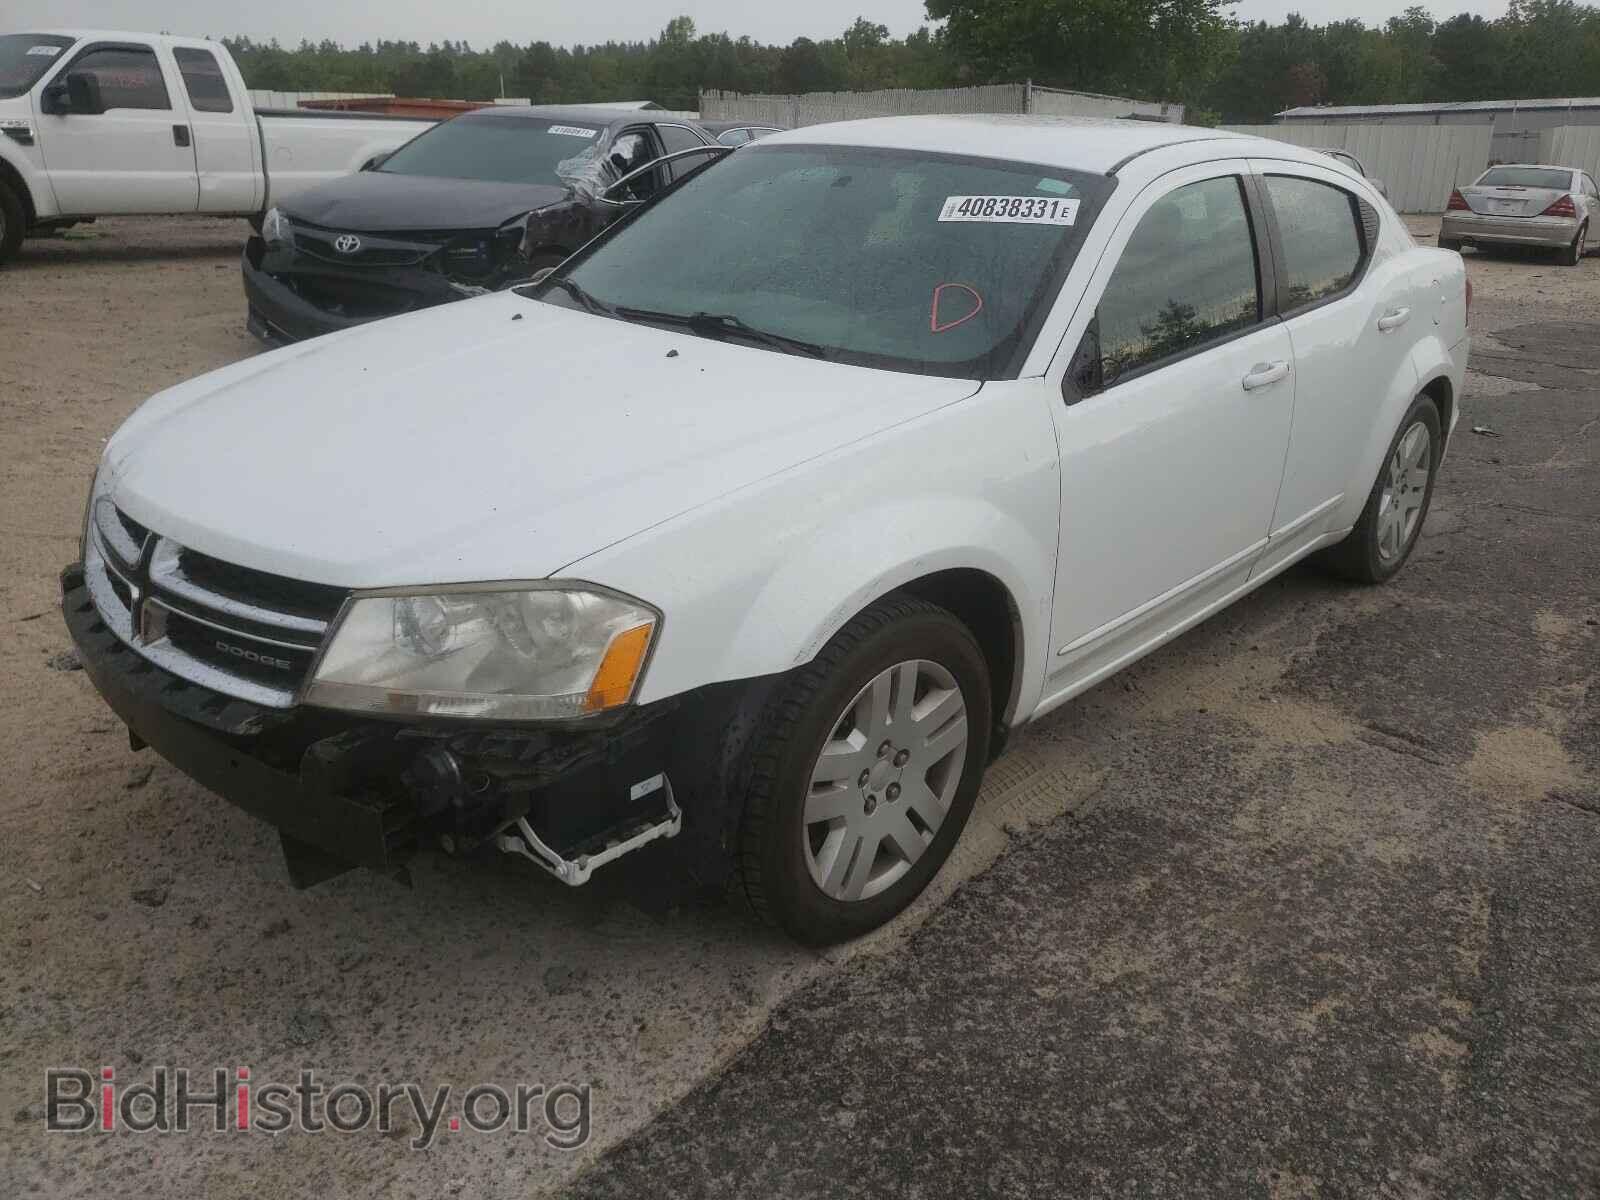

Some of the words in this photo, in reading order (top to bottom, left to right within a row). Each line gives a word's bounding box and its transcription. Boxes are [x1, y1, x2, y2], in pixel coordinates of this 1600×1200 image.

[957, 198, 1060, 219] 40838331
[1061, 207, 1070, 218] E
[931, 283, 983, 332] D
[215, 640, 292, 670] DODGE
